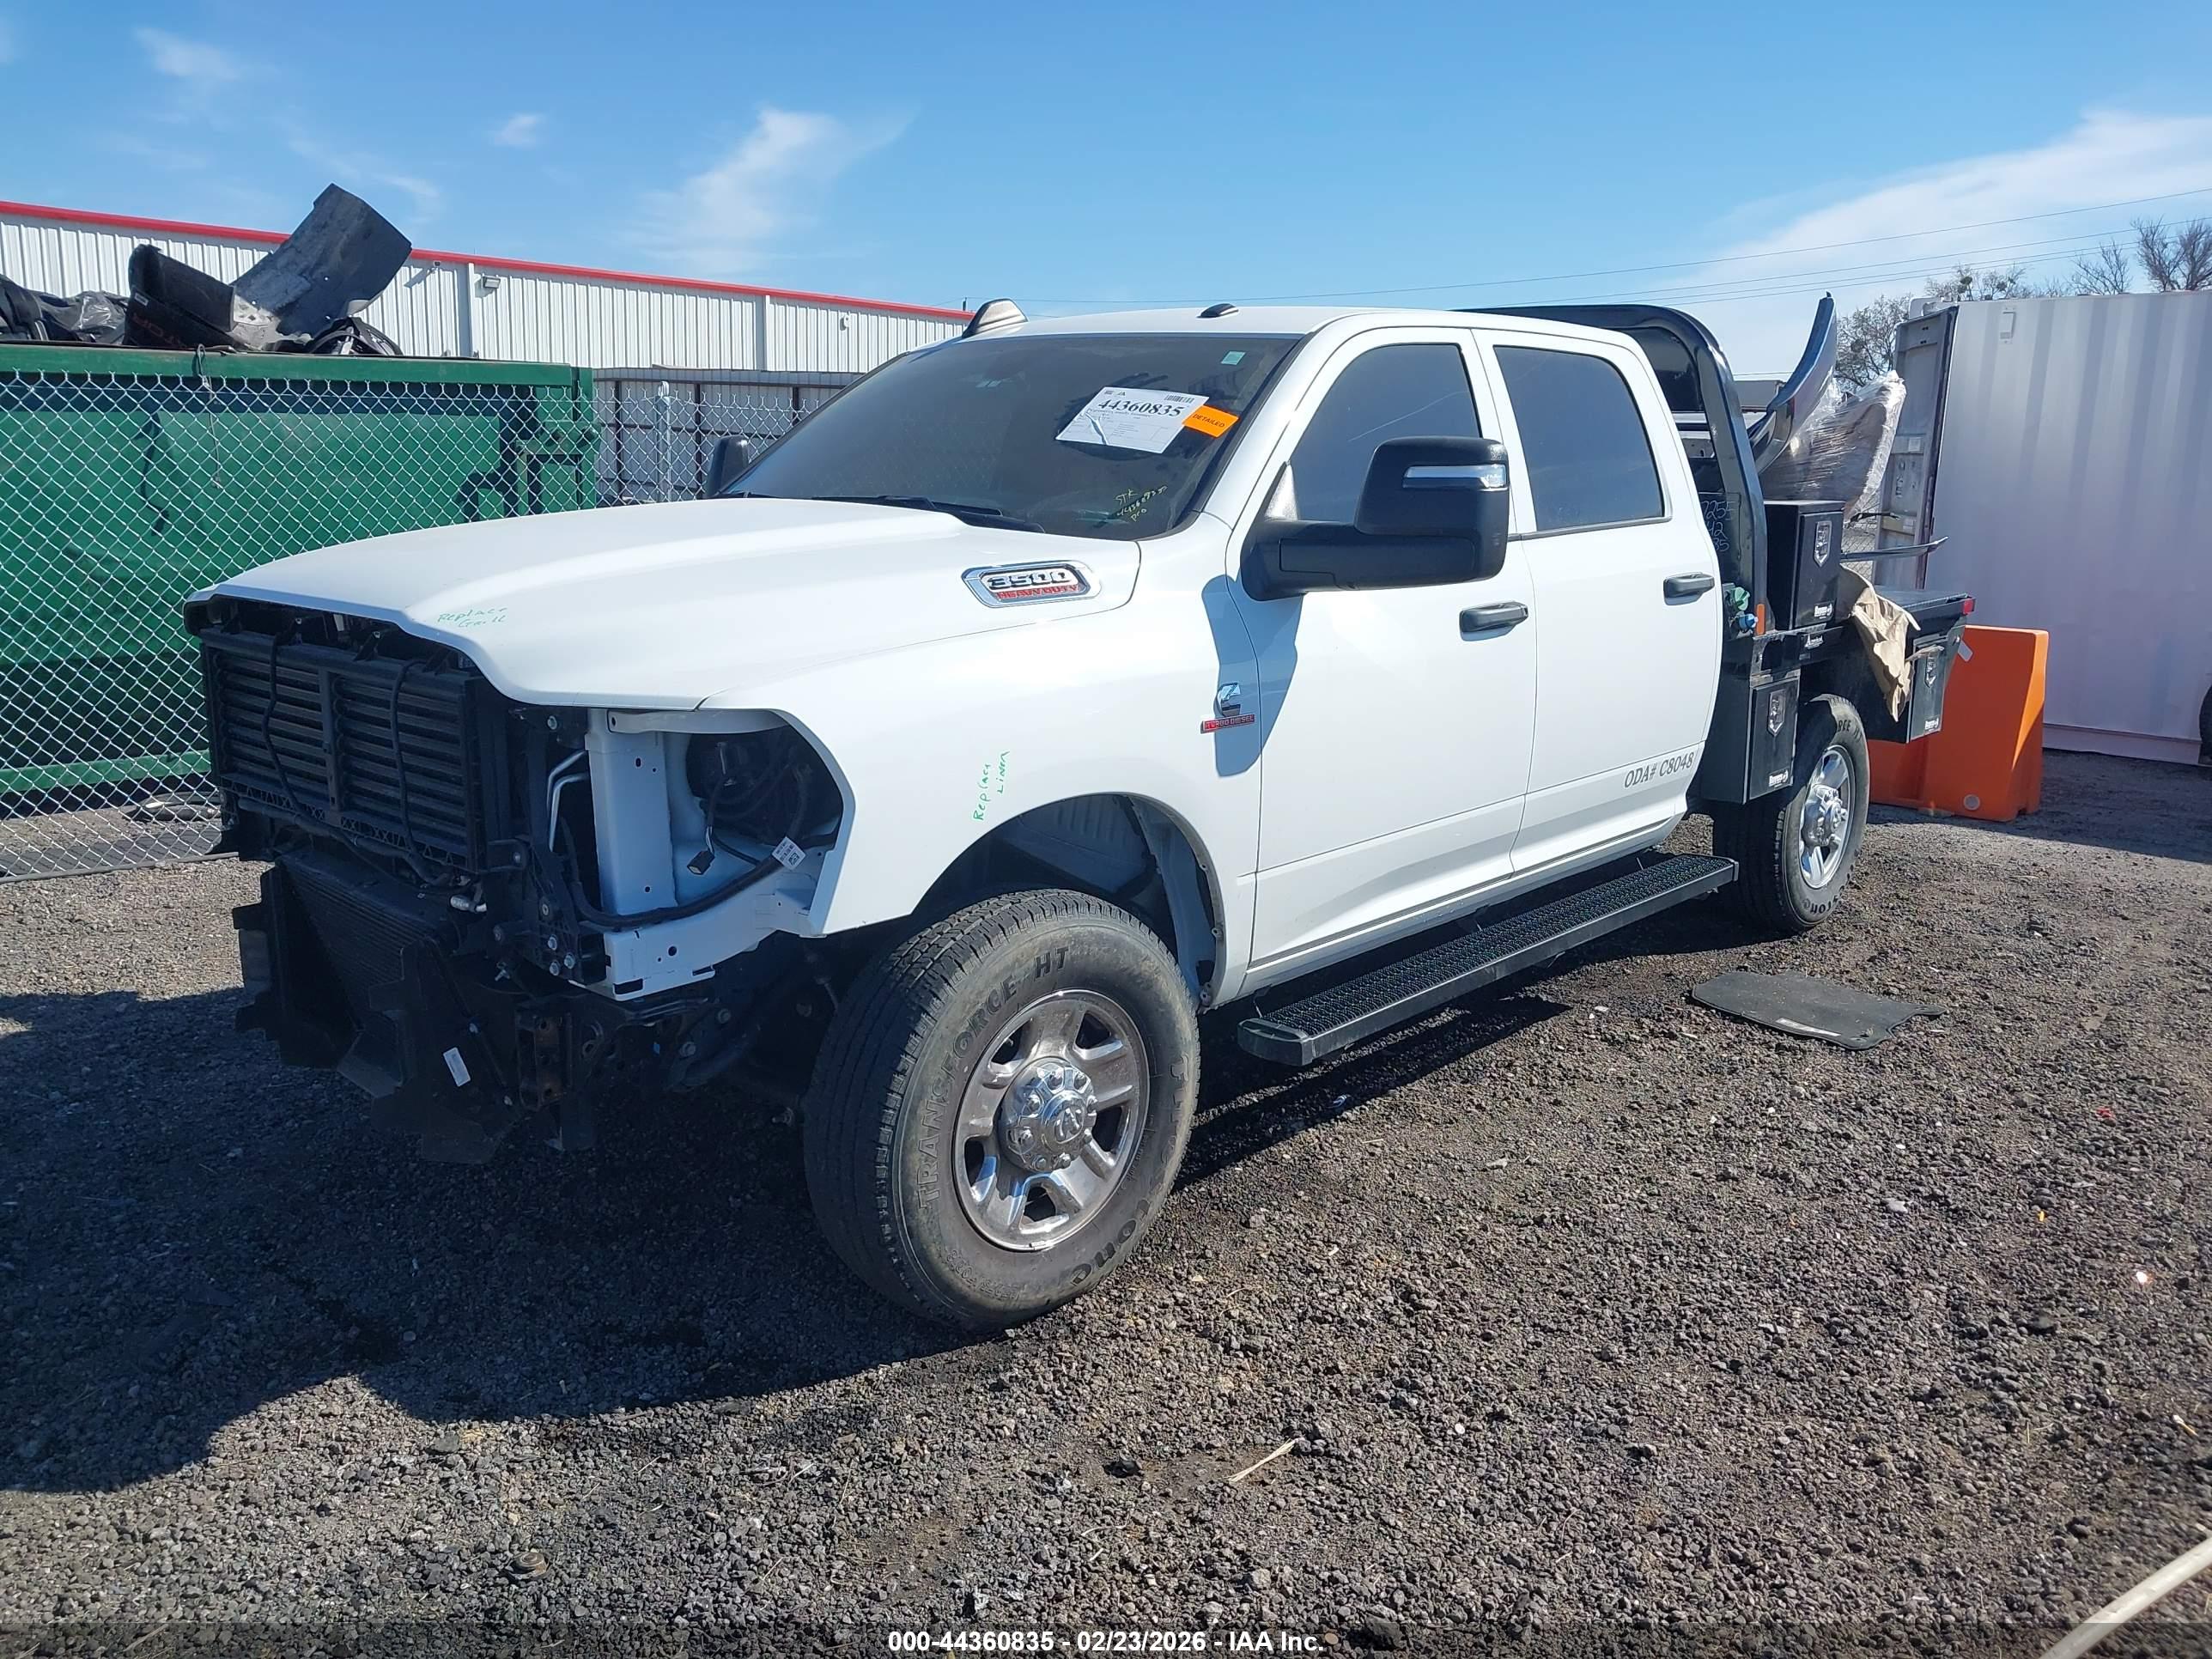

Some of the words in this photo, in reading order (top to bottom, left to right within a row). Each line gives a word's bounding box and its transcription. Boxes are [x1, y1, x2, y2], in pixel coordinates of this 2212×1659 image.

[1098, 398, 1185, 417] 44360835
[1192, 413, 1226, 428] DETAILED
[988, 570, 1071, 590] 3500
[1624, 763, 1658, 788] ODA#
[1659, 751, 1694, 777] C8048
[916, 975, 1018, 1210] TRANSFORCE
[1033, 946, 1069, 981] HT
